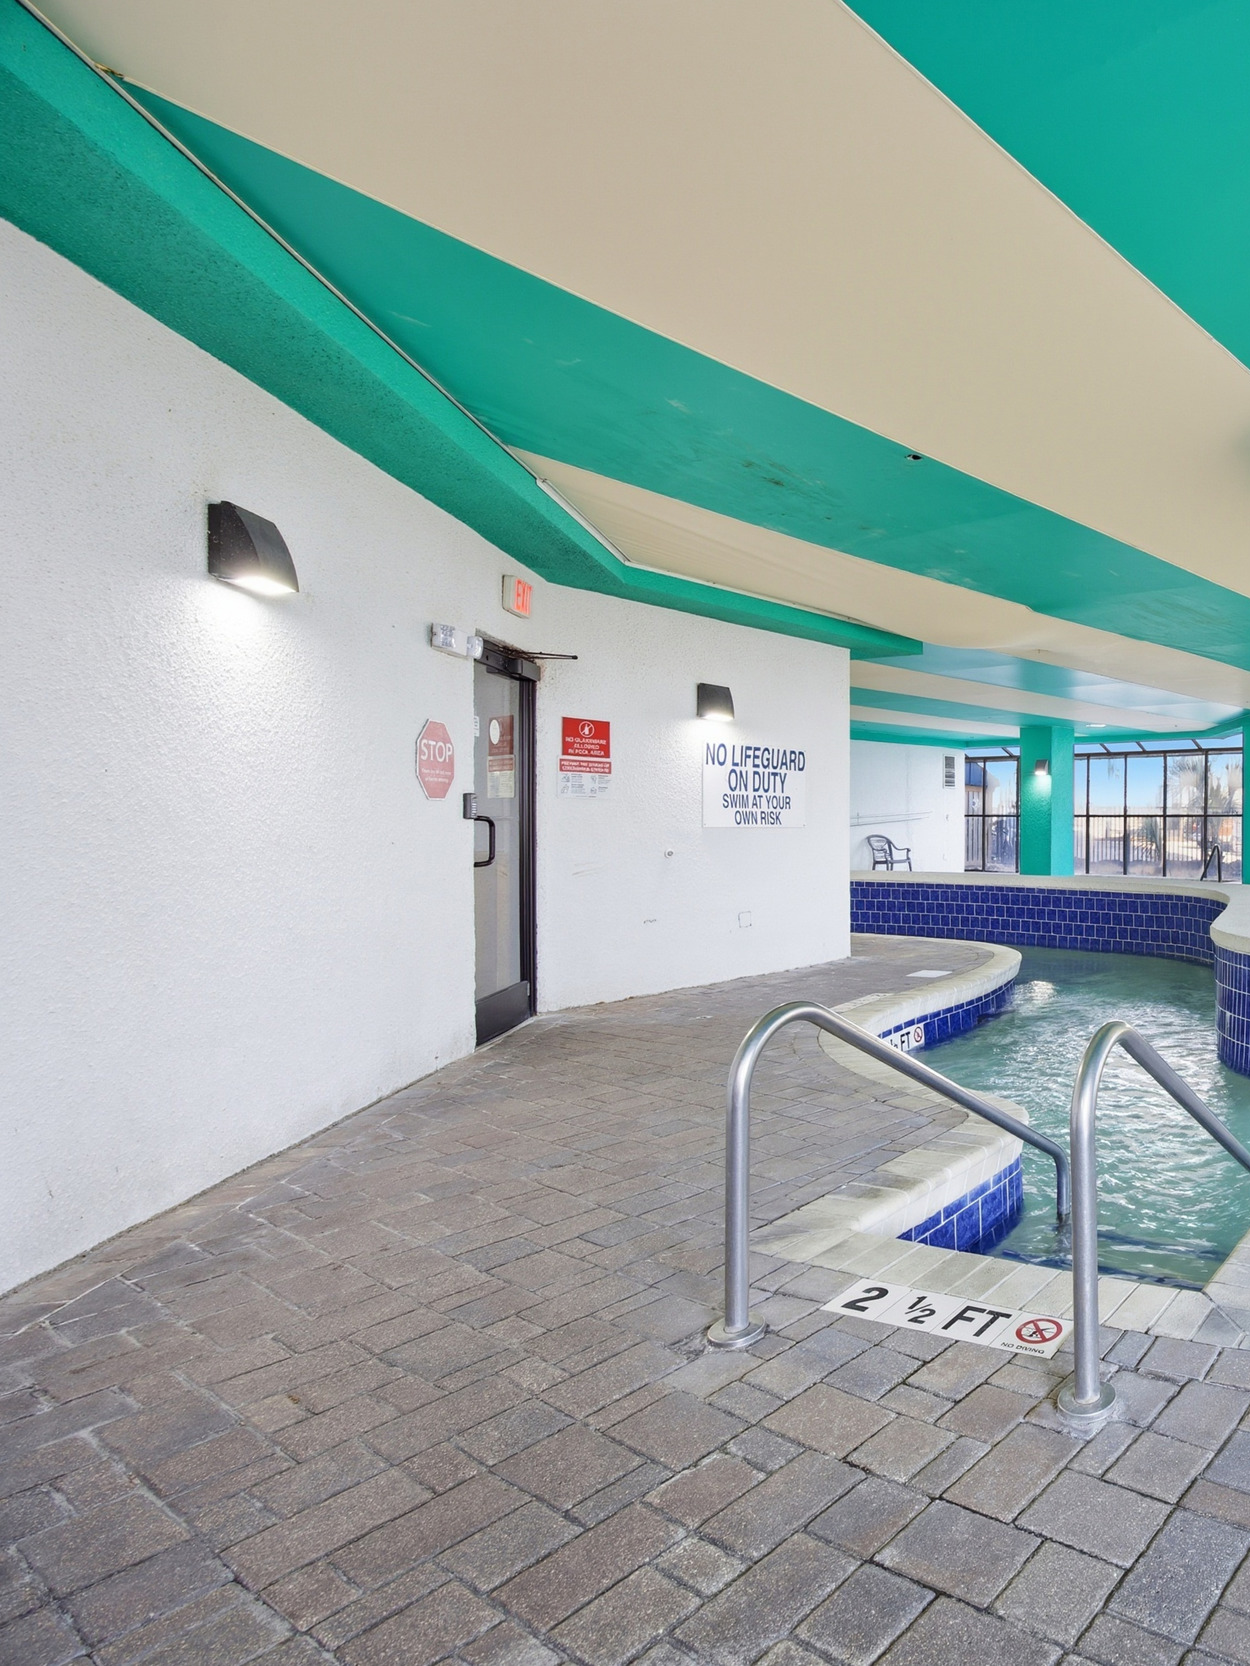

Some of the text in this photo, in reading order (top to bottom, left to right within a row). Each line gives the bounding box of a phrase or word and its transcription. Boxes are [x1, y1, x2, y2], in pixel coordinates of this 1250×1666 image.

[515, 578, 532, 616] EXIT
[420, 739, 453, 763] STOP
[705, 742, 806, 772] NO LIFEGUARD
[728, 768, 788, 794] ON DUTY
[722, 793, 791, 810] SWIM AT YOUR
[734, 810, 782, 826] OWN RISK
[900, 1031, 911, 1052] FT
[841, 1286, 889, 1313] 2
[941, 1305, 1013, 1338] FT
[1000, 1341, 1046, 1355] NO DIVING
